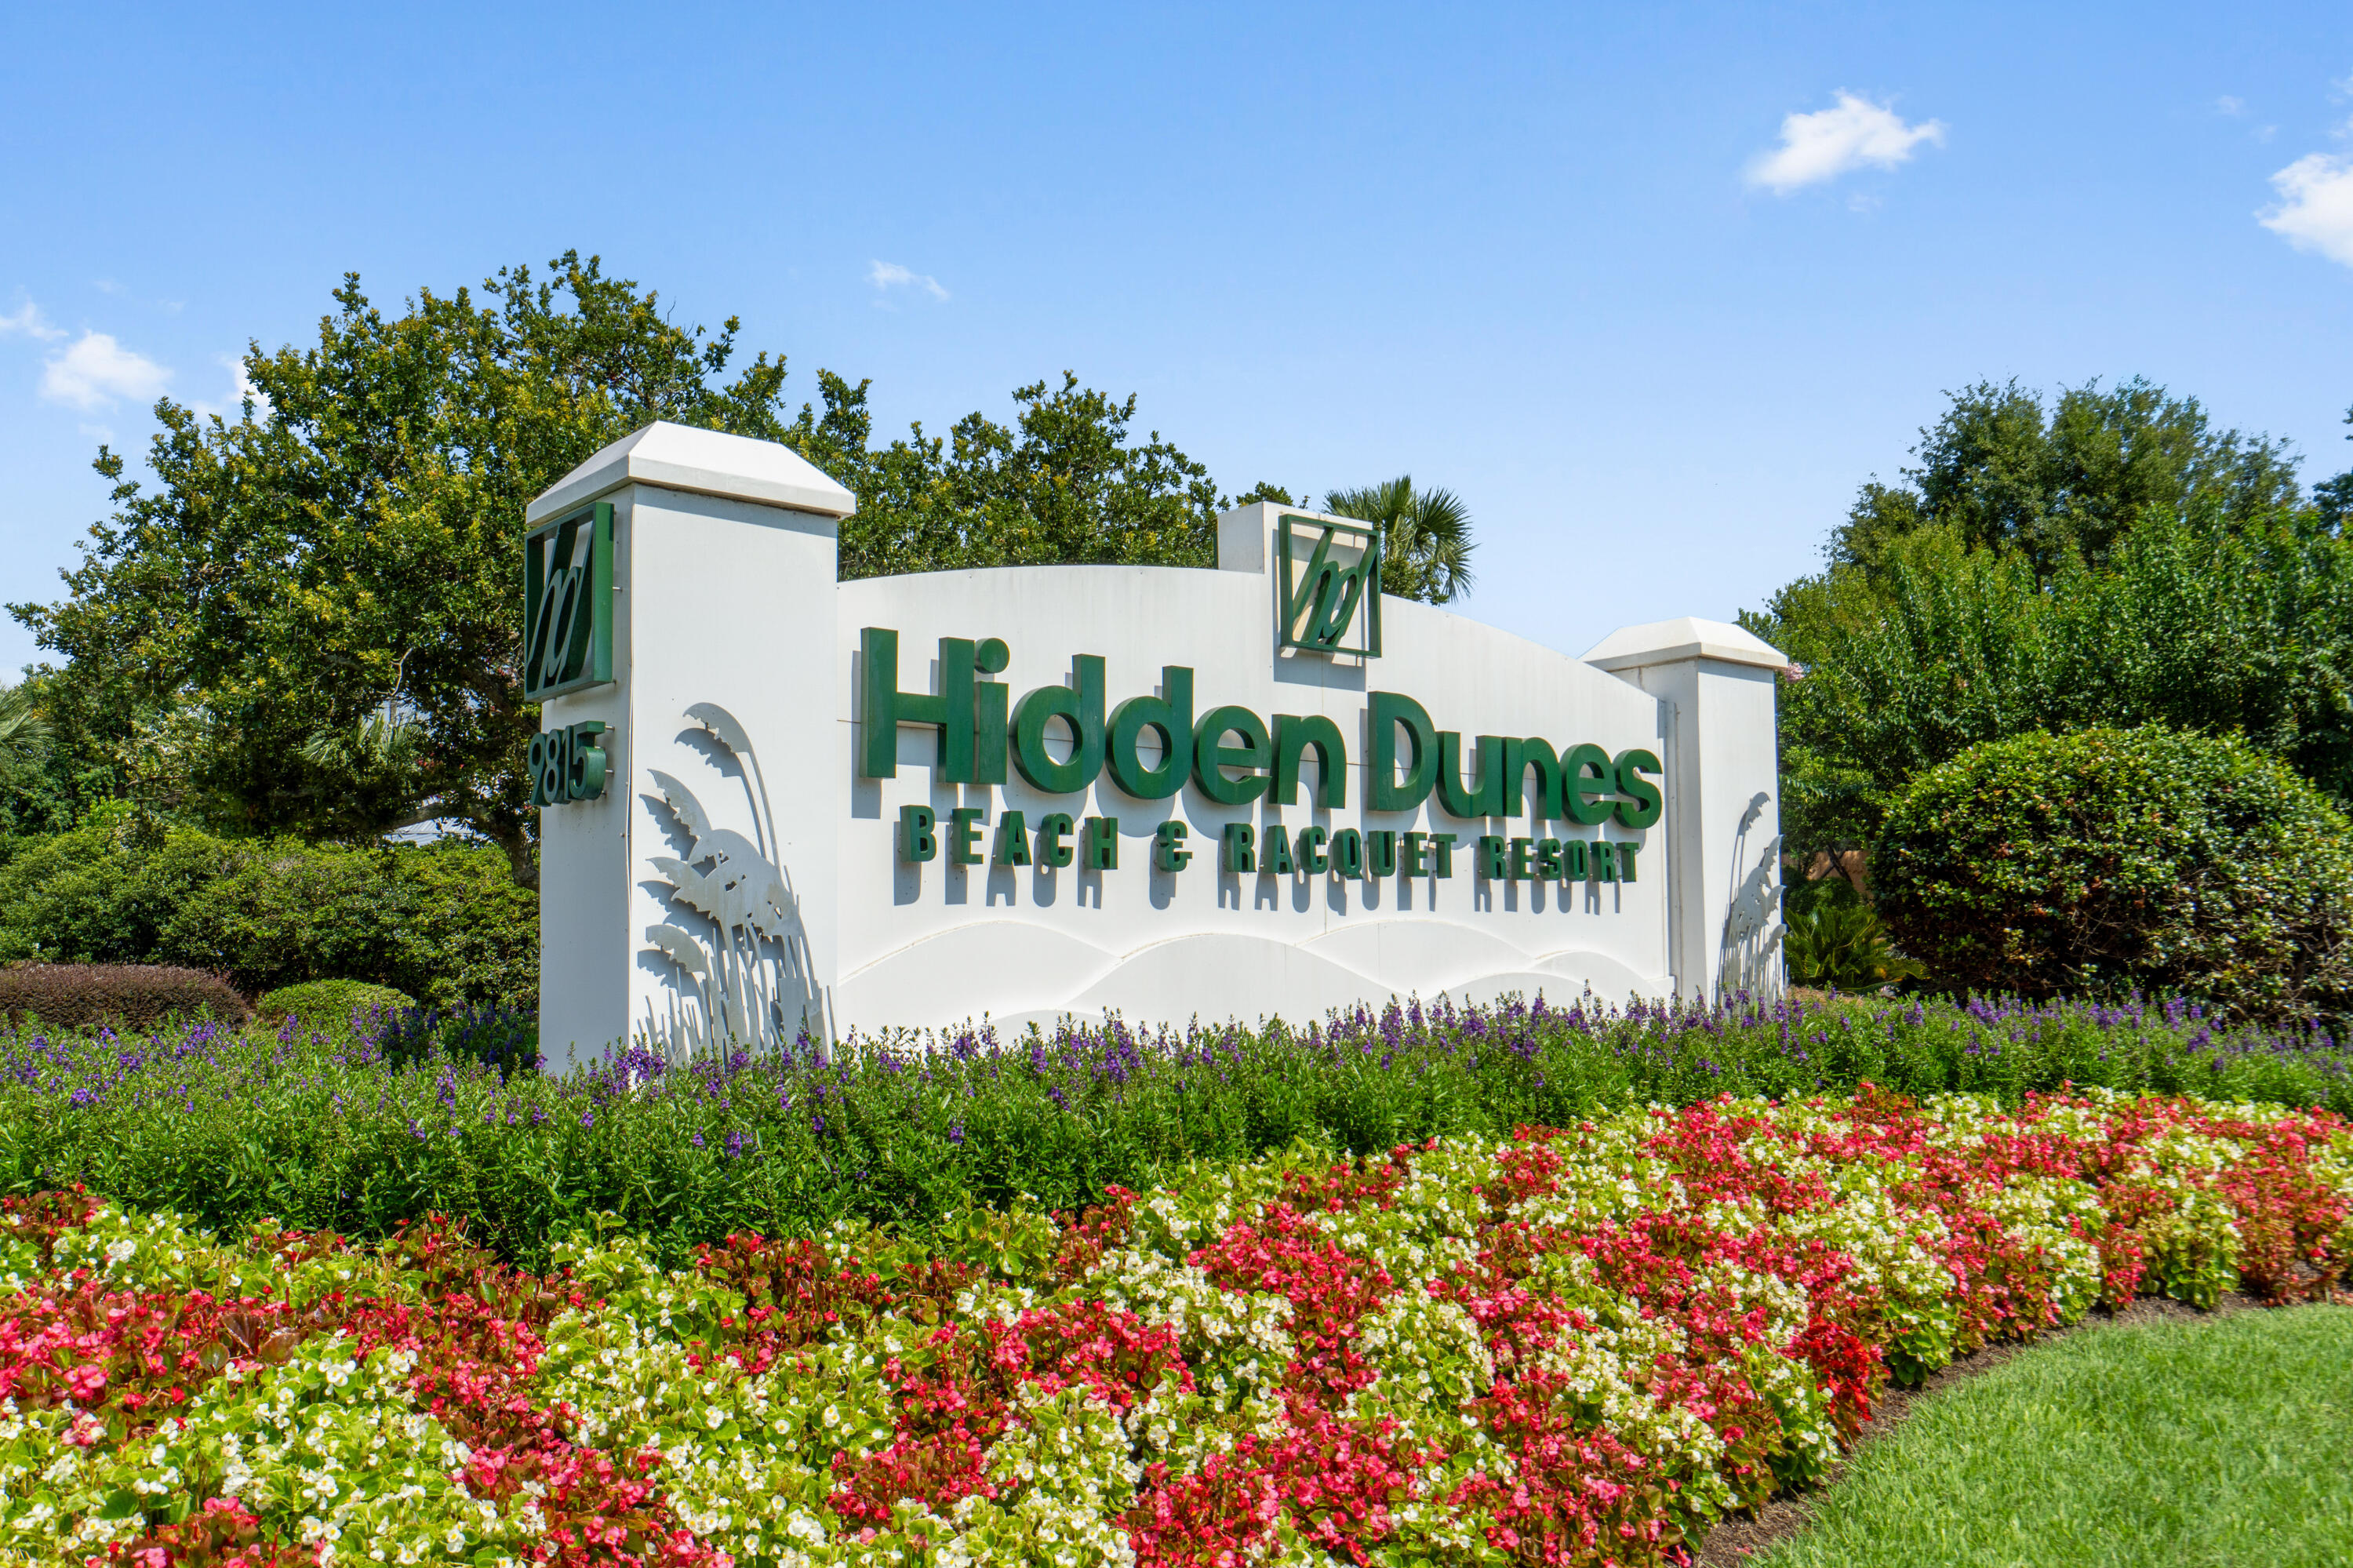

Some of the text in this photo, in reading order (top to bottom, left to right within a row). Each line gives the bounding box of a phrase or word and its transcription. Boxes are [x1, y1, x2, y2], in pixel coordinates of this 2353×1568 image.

[527, 720, 607, 807] 9815
[860, 626, 1664, 830] Hidden Dunes
[900, 804, 1639, 883] BEACH & RACQUET RESORT
